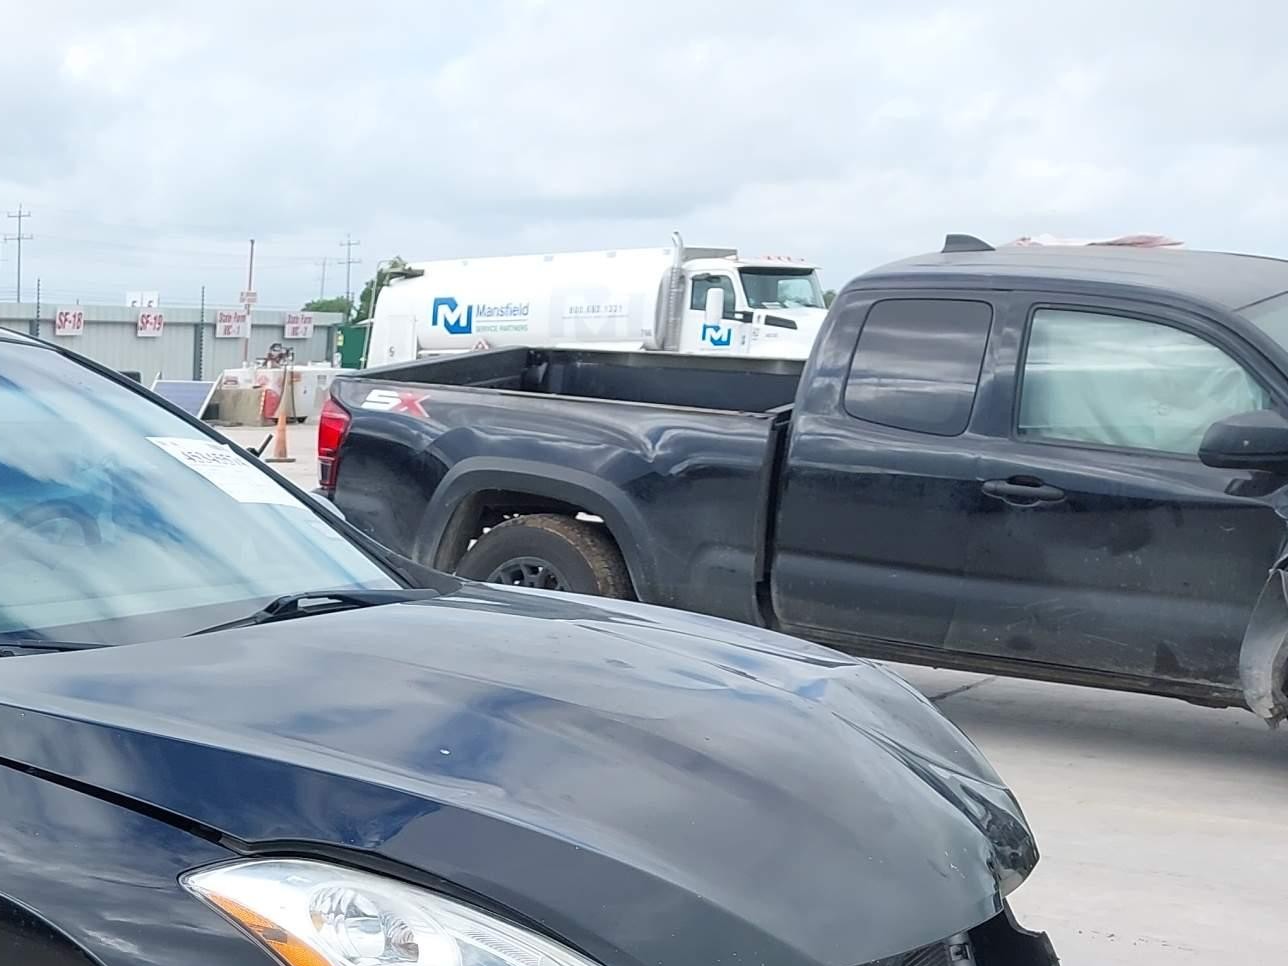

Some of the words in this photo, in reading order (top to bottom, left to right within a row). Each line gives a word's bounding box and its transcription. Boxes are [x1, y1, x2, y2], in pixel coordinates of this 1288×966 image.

[476, 301, 529, 318] Mansfield
[57, 311, 83, 330] SF-18
[139, 314, 163, 331] SF-19
